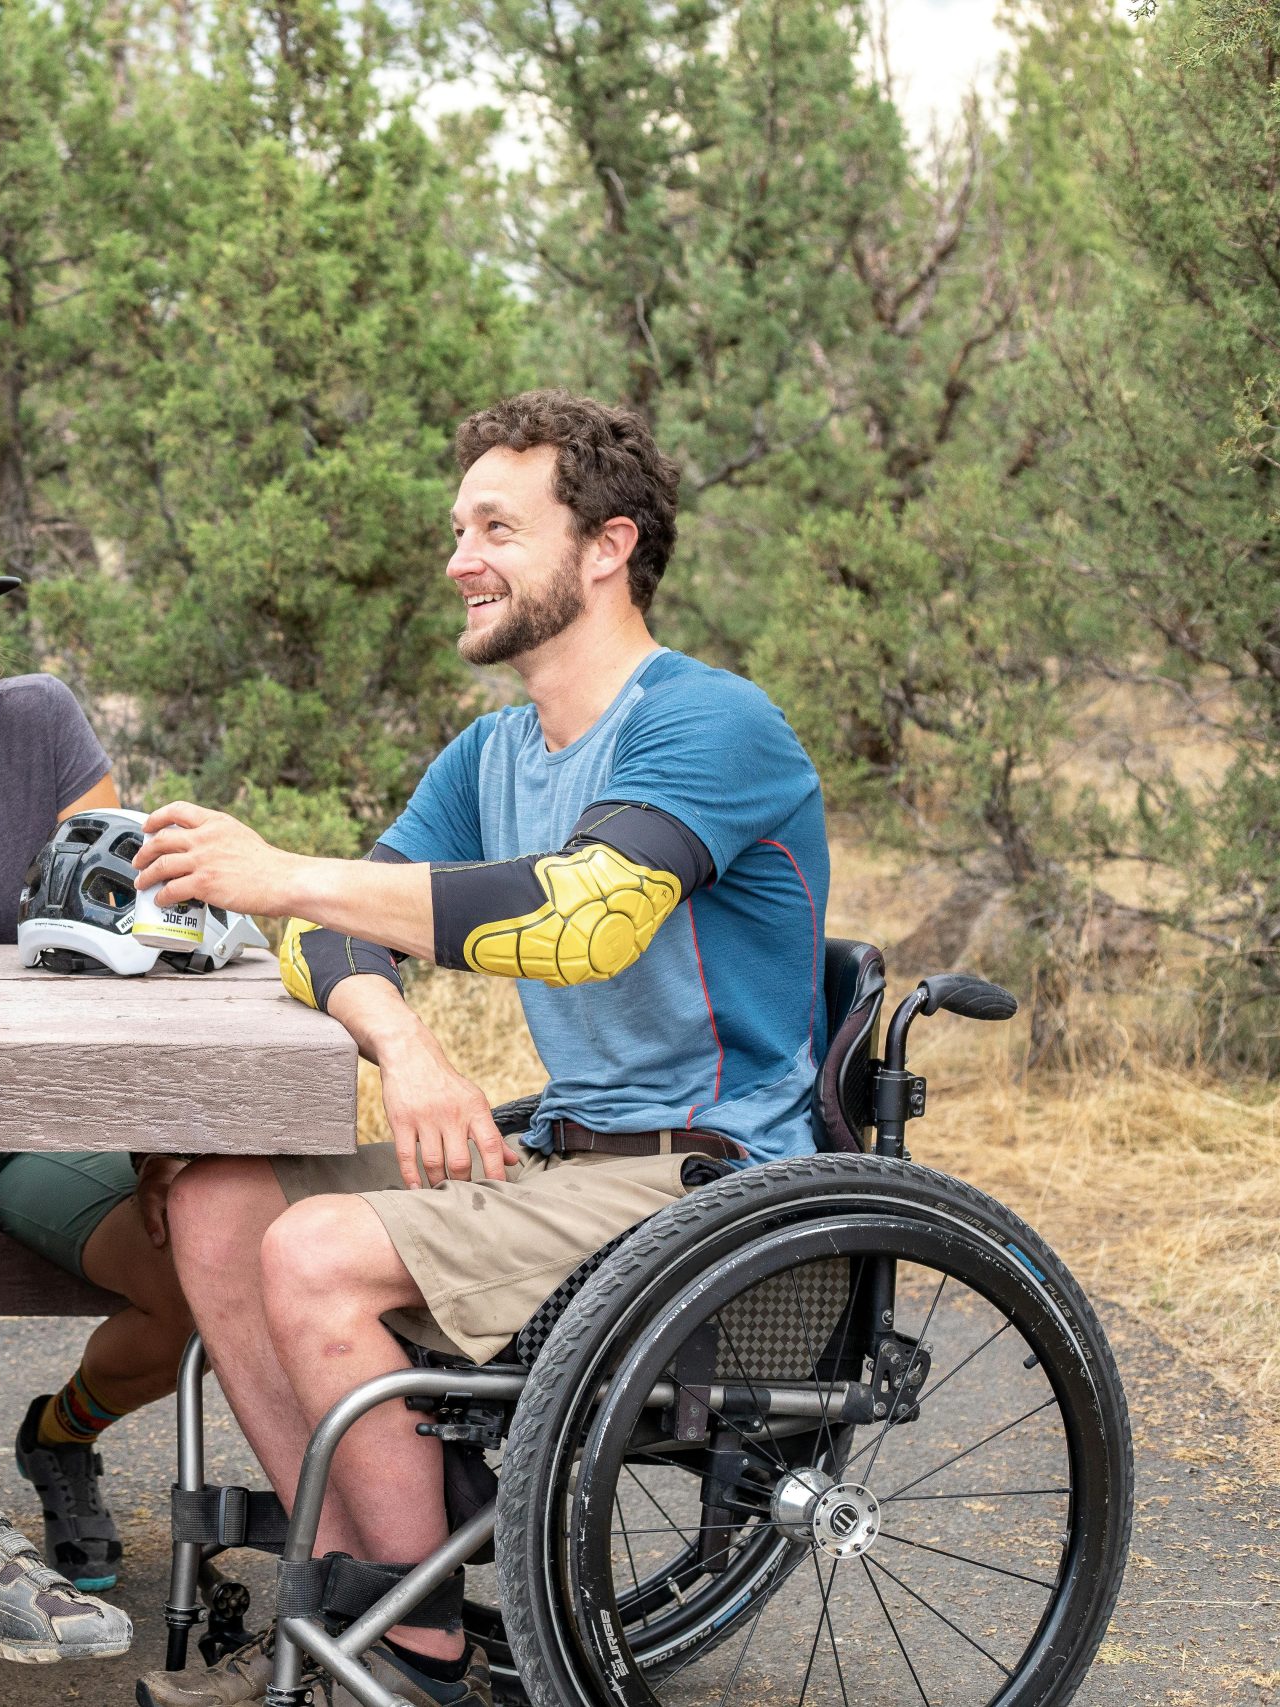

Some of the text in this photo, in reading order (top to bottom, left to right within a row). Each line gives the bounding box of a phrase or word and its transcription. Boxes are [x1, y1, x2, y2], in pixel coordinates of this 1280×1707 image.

[163, 913, 198, 929] JOE IPA
[1044, 1283, 1093, 1360] PLUS TOUR
[600, 1608, 630, 1677] SURGE
[643, 1626, 712, 1669] PLUS TOUR
